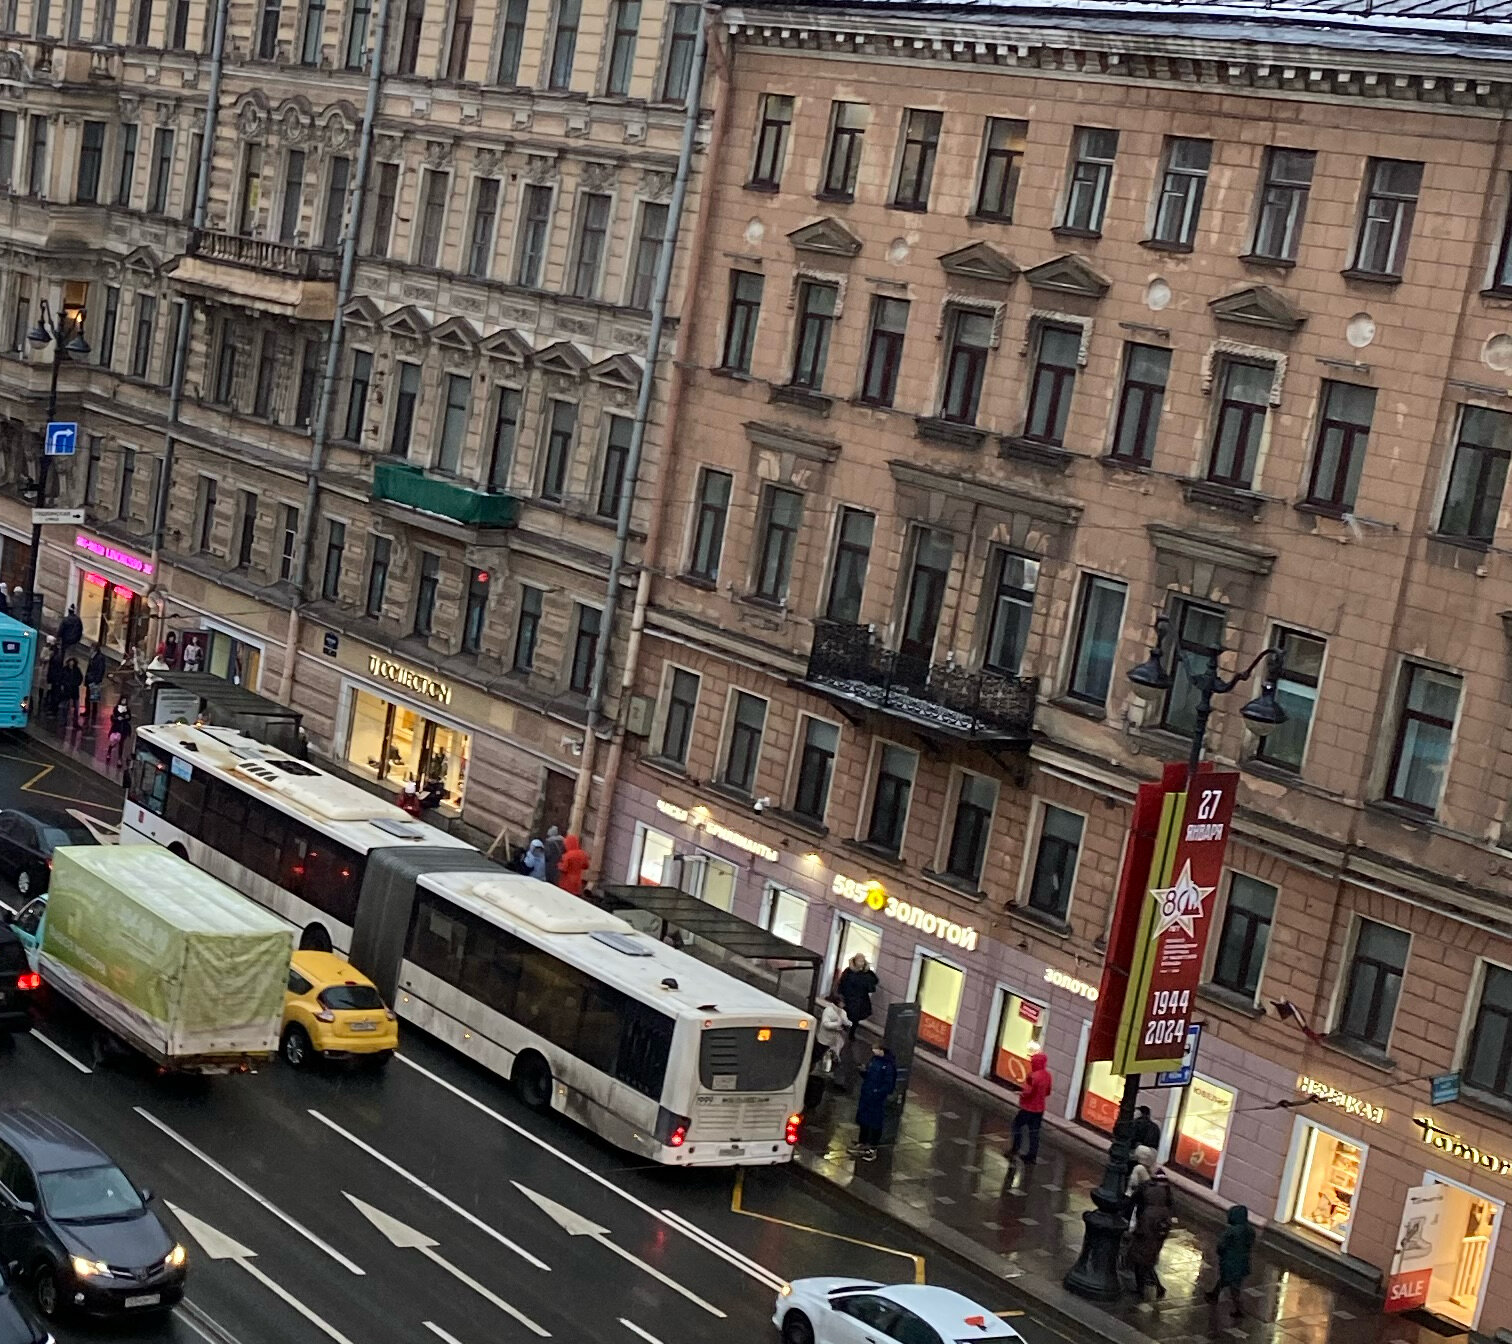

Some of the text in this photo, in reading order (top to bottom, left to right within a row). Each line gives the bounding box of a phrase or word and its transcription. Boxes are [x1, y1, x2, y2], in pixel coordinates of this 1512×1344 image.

[1197, 789, 1223, 820] 27
[1185, 823, 1224, 841] ЯНВАРЯ
[832, 873, 980, 952] 585 ЗОЛОТОЙ
[1152, 989, 1190, 1016] 1944
[1144, 1019, 1185, 1046] 2024
[1390, 1280, 1425, 1301] SALE
